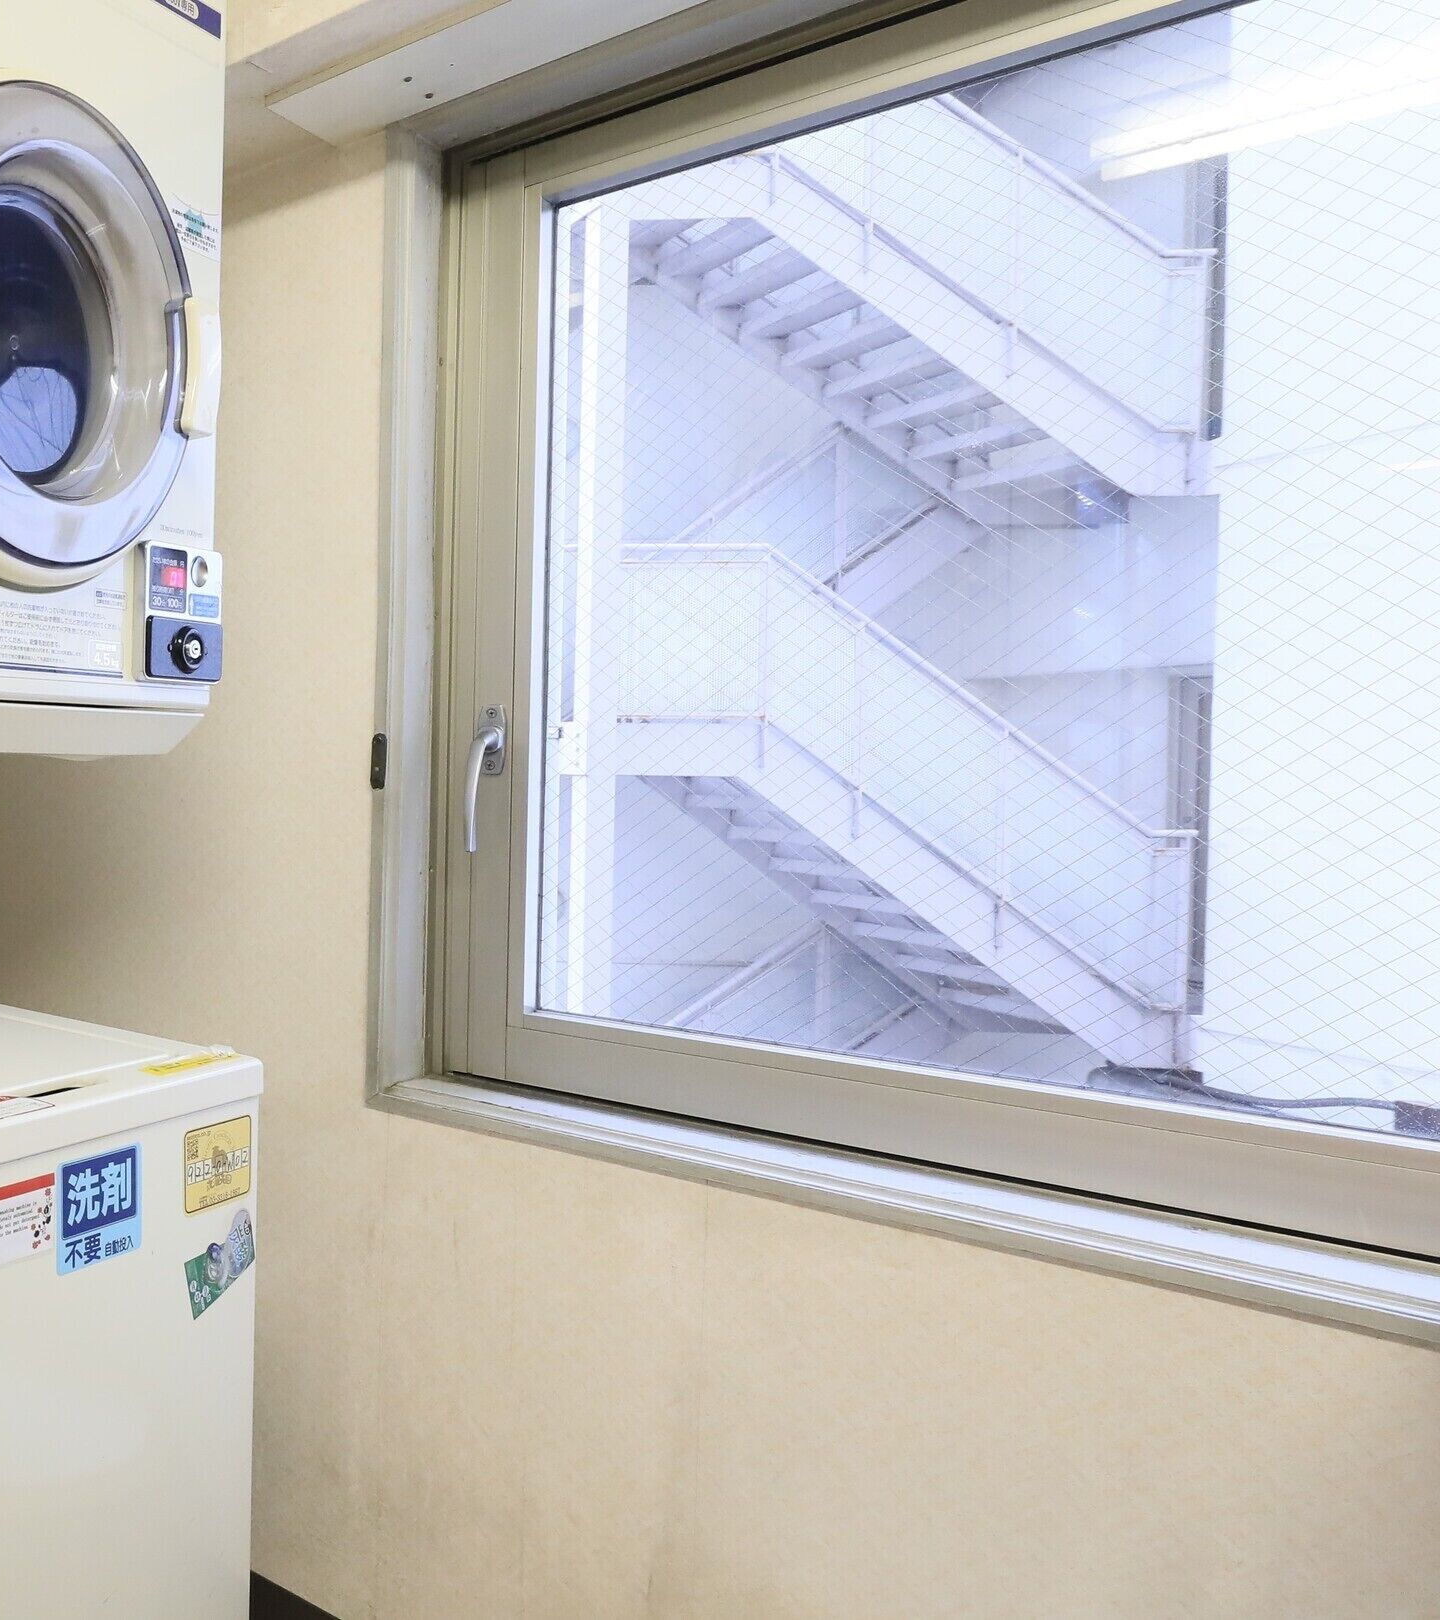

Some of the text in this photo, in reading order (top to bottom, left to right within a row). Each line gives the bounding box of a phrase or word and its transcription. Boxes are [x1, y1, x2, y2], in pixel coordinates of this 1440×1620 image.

[66, 1161, 133, 1227] 洗剤
[64, 1233, 134, 1268] 不要 自動投入
